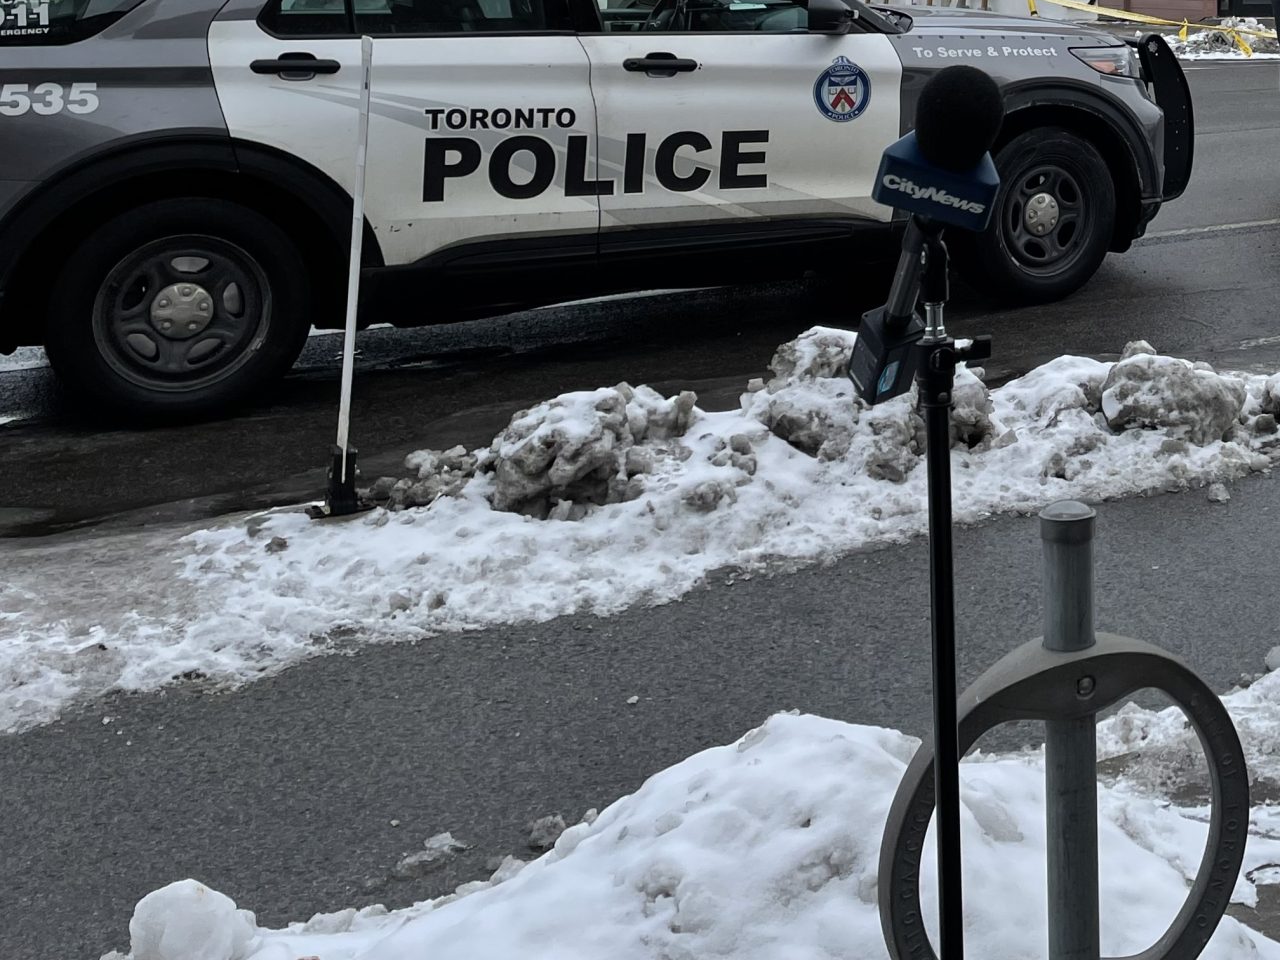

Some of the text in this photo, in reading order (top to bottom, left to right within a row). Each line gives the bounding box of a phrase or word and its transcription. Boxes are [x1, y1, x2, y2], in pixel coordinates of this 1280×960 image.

[913, 46, 1058, 58] To Serve & Protect
[425, 107, 576, 130] TORONTO
[422, 129, 770, 202] POLICE
[882, 174, 986, 214] CityNews
